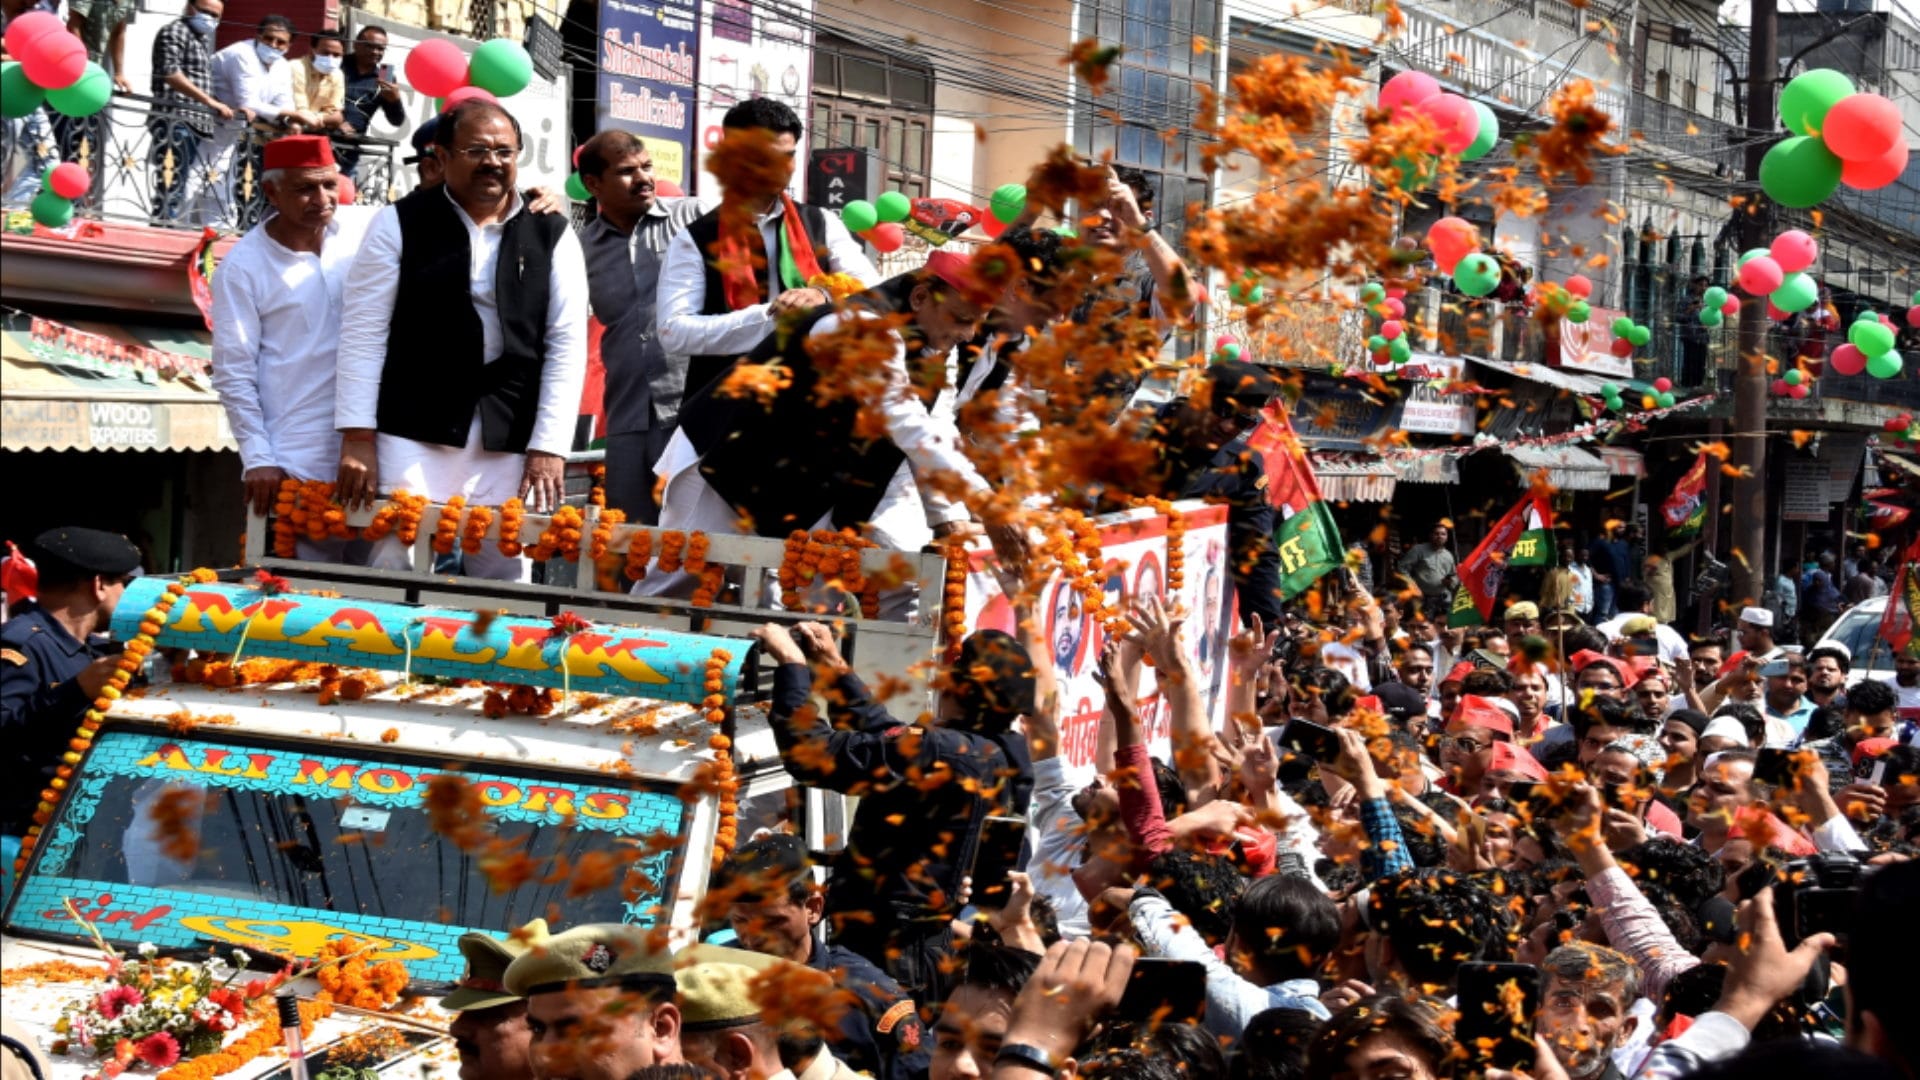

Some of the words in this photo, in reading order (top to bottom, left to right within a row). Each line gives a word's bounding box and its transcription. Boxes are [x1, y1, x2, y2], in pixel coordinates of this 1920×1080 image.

[603, 28, 693, 87] Shakuntala
[610, 82, 685, 129] Handicrafts
[90, 427, 158, 445] EXPORTERS
[91, 403, 152, 425] WOOD
[170, 590, 672, 685] MALIK
[135, 743, 274, 779] ALI
[294, 759, 631, 819] MOORS
